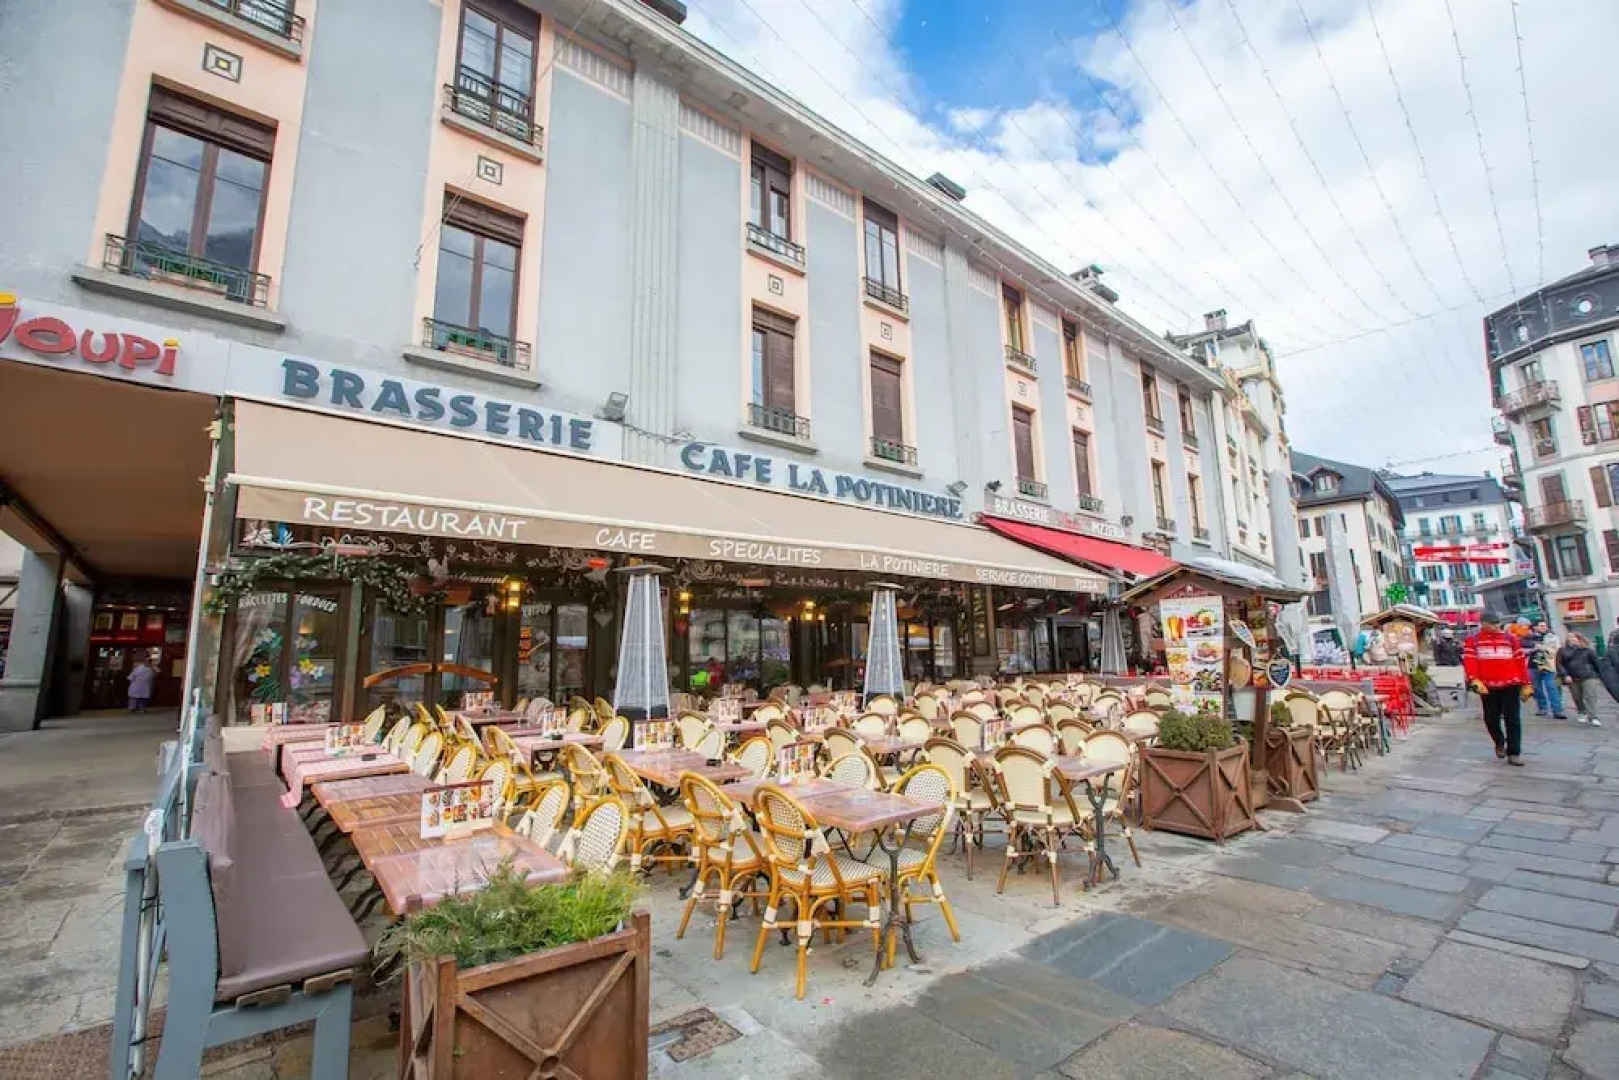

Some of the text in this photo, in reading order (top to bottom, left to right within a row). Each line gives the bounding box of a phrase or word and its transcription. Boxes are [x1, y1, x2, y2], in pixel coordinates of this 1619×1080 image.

[282, 359, 593, 449] BRASSERIE
[681, 441, 964, 519] CAFE LA POTINIERE
[995, 499, 1050, 523] BRASSERIE
[303, 496, 526, 539] RESTAURANT
[595, 528, 656, 550] CAFE
[710, 540, 822, 564] SPECIALITES
[861, 554, 880, 569] LA
[884, 556, 949, 576] POTINIERE
[976, 568, 1017, 584] SERVICE
